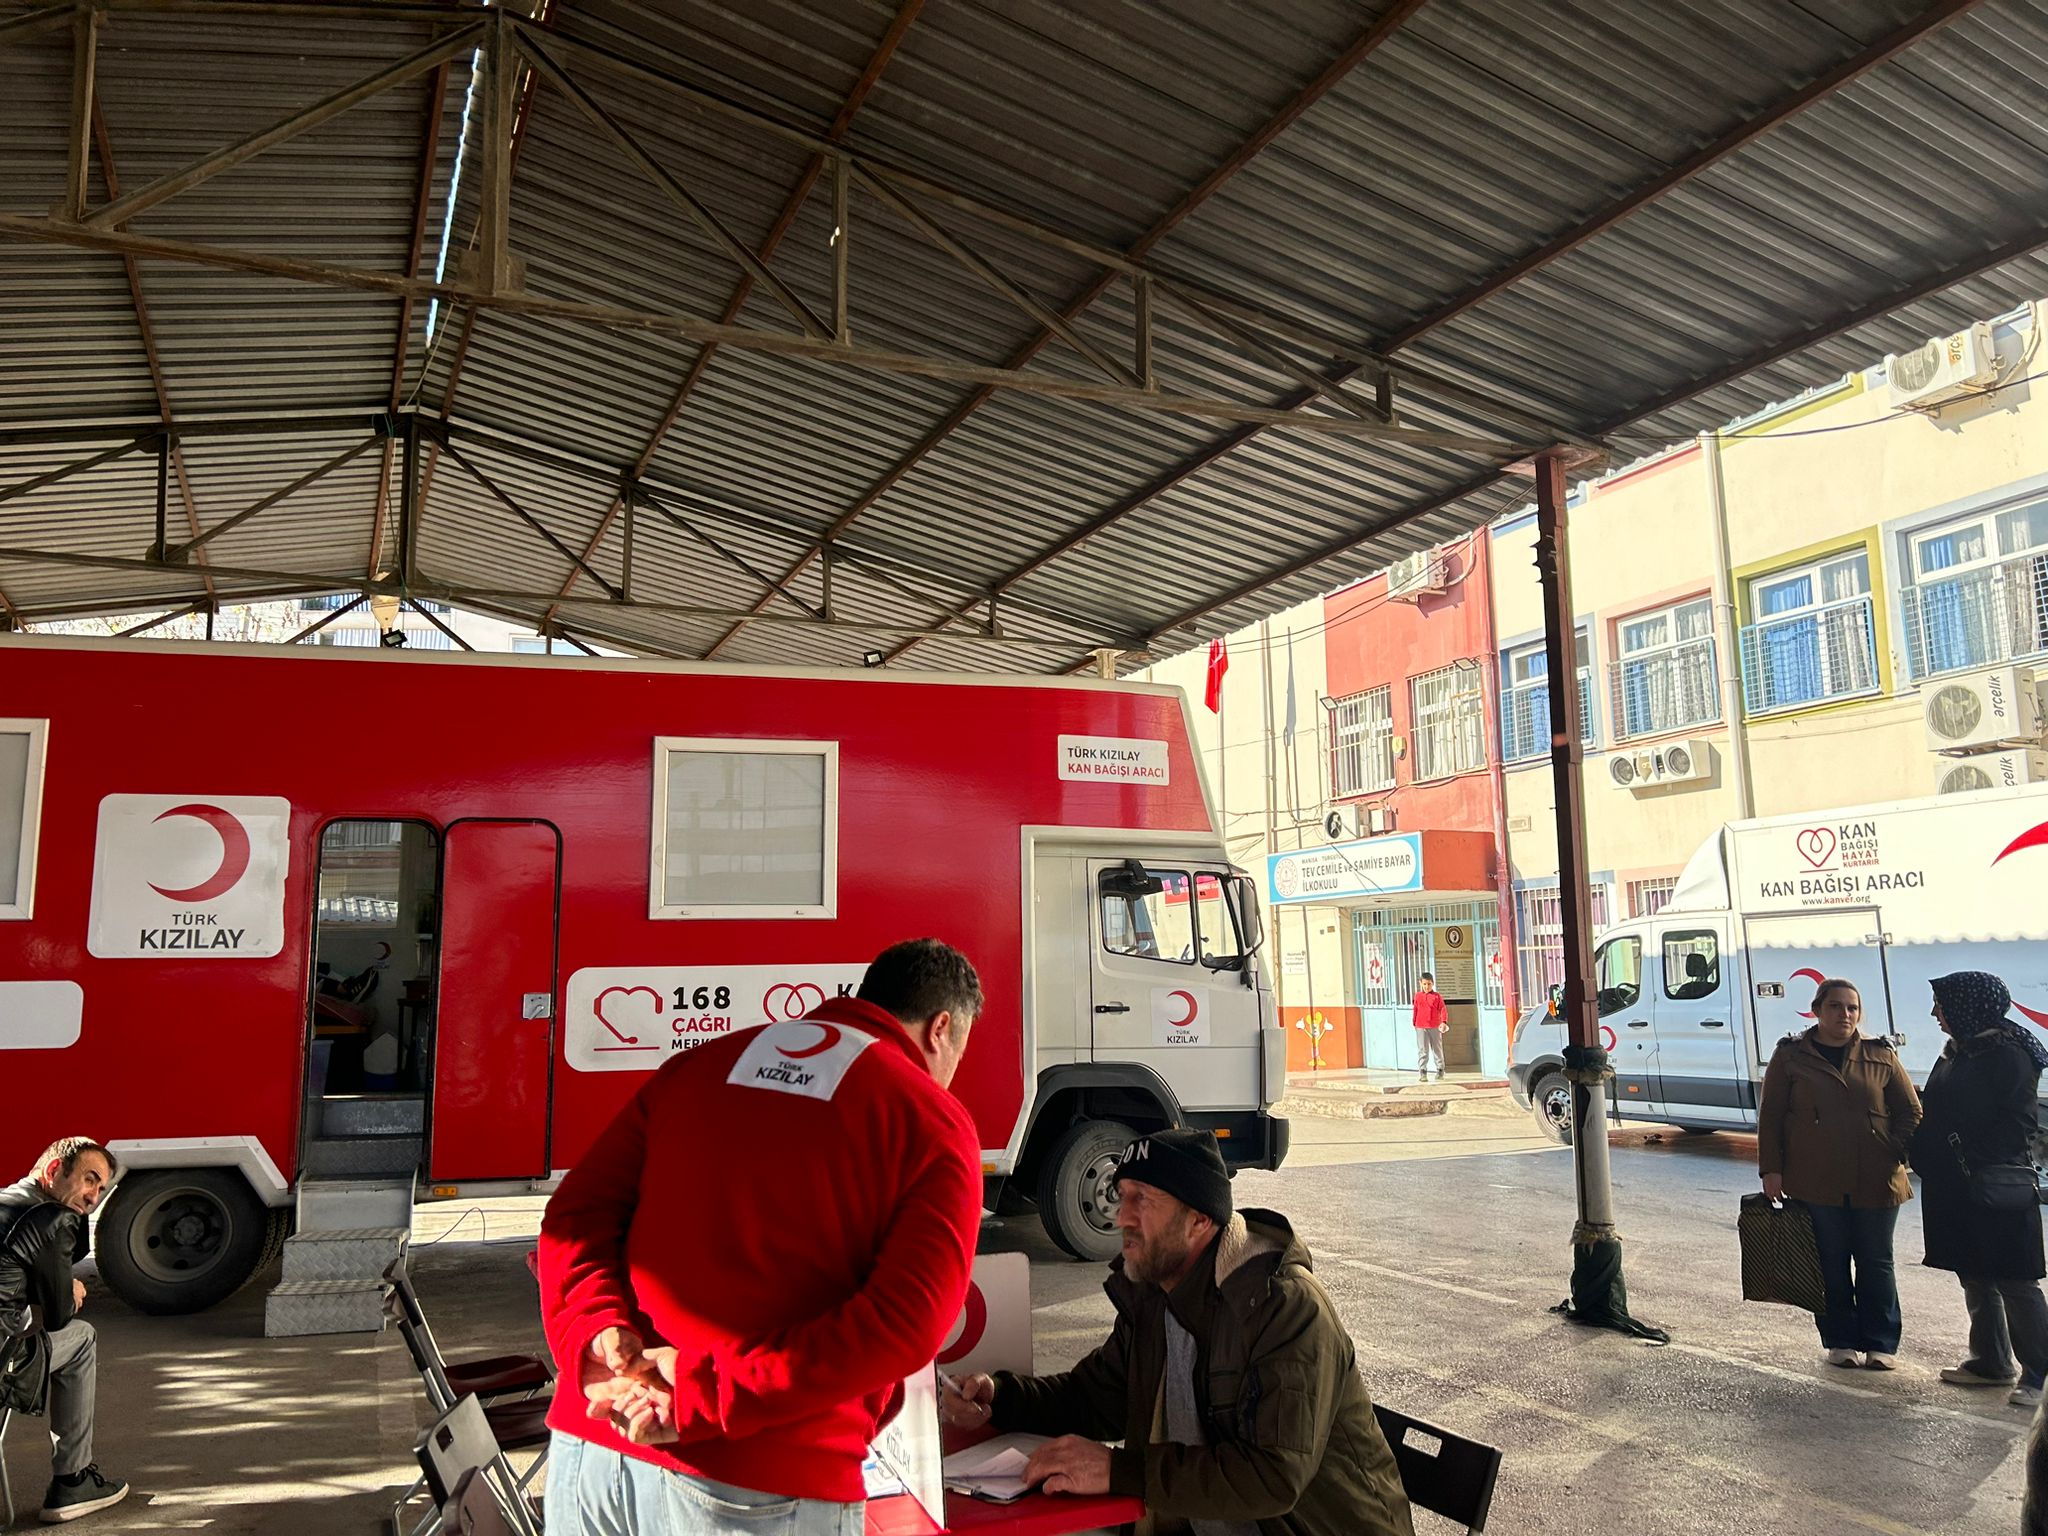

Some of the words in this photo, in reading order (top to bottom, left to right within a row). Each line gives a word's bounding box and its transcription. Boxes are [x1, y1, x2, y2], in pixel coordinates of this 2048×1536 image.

[1987, 675, 2006, 718] arçelik
[1067, 746, 1097, 759] TÜRK
[1100, 749, 1140, 761] KIZILAY
[1068, 763, 1091, 774] KAN
[1094, 763, 1130, 777] BAĞIŞI
[1132, 766, 1164, 778] ARACI
[2000, 757, 2018, 787] çelik
[1839, 821, 1876, 840] KAN
[1841, 839, 1878, 851] BAĞIŞI
[1842, 849, 1878, 860] HAYAT
[1302, 867, 1315, 878] TEV
[1316, 863, 1343, 876] CEMİLE
[1344, 864, 1353, 872] ve
[1384, 854, 1411, 868] BAYAR
[1843, 858, 1879, 868] KURTARIR
[1302, 878, 1338, 892] İLKOKULU
[1761, 881, 1795, 897] KAN
[1800, 873, 1859, 896] BAĞIŞI
[1866, 871, 1924, 890] ARACI
[1802, 895, 1871, 905] www.kanver.org
[172, 911, 217, 925] TÜRK
[140, 929, 245, 949] KIZILAY
[672, 986, 731, 1010] 168
[838, 983, 856, 998] K
[672, 1014, 731, 1036] ÇAĞRI
[1167, 1036, 1199, 1044] KIZILAY
[756, 1066, 814, 1085] KIZILAY
